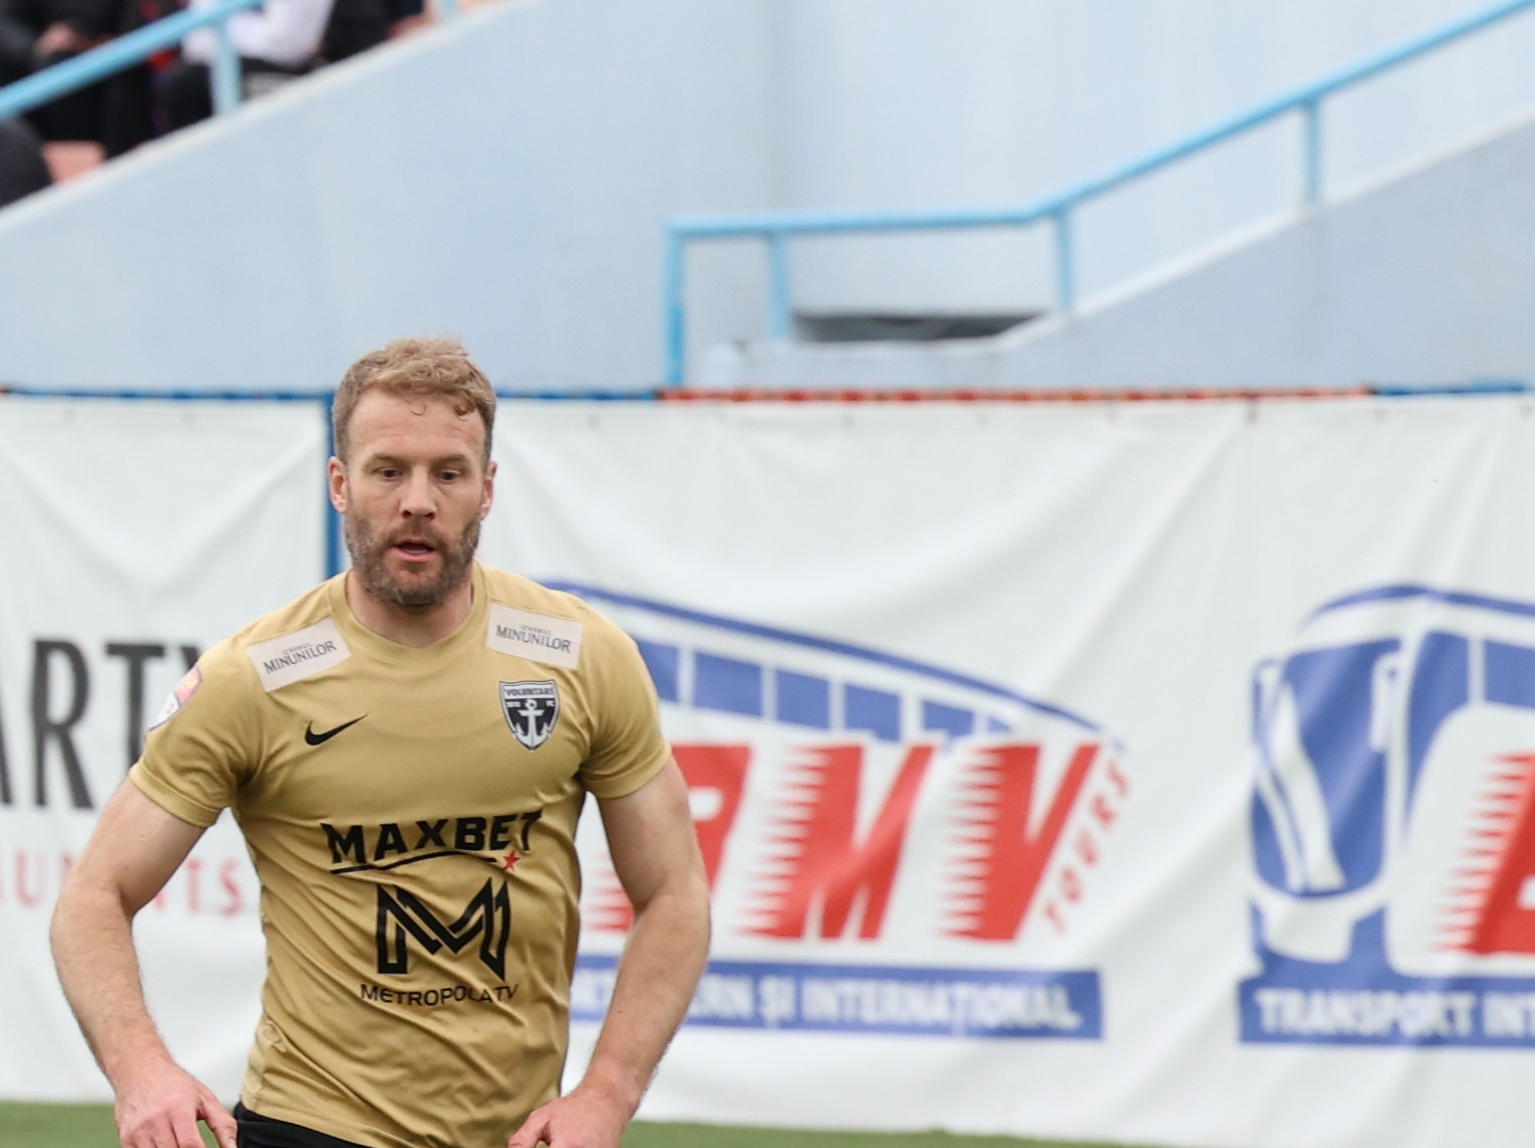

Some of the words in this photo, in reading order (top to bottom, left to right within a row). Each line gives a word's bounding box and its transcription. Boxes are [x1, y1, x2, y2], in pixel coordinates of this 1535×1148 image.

[263, 640, 338, 674] MINUNILOR
[495, 624, 573, 654] MINUNILOR
[320, 808, 543, 865] MAXBET
[1254, 987, 1476, 1038] TRANSPORT
